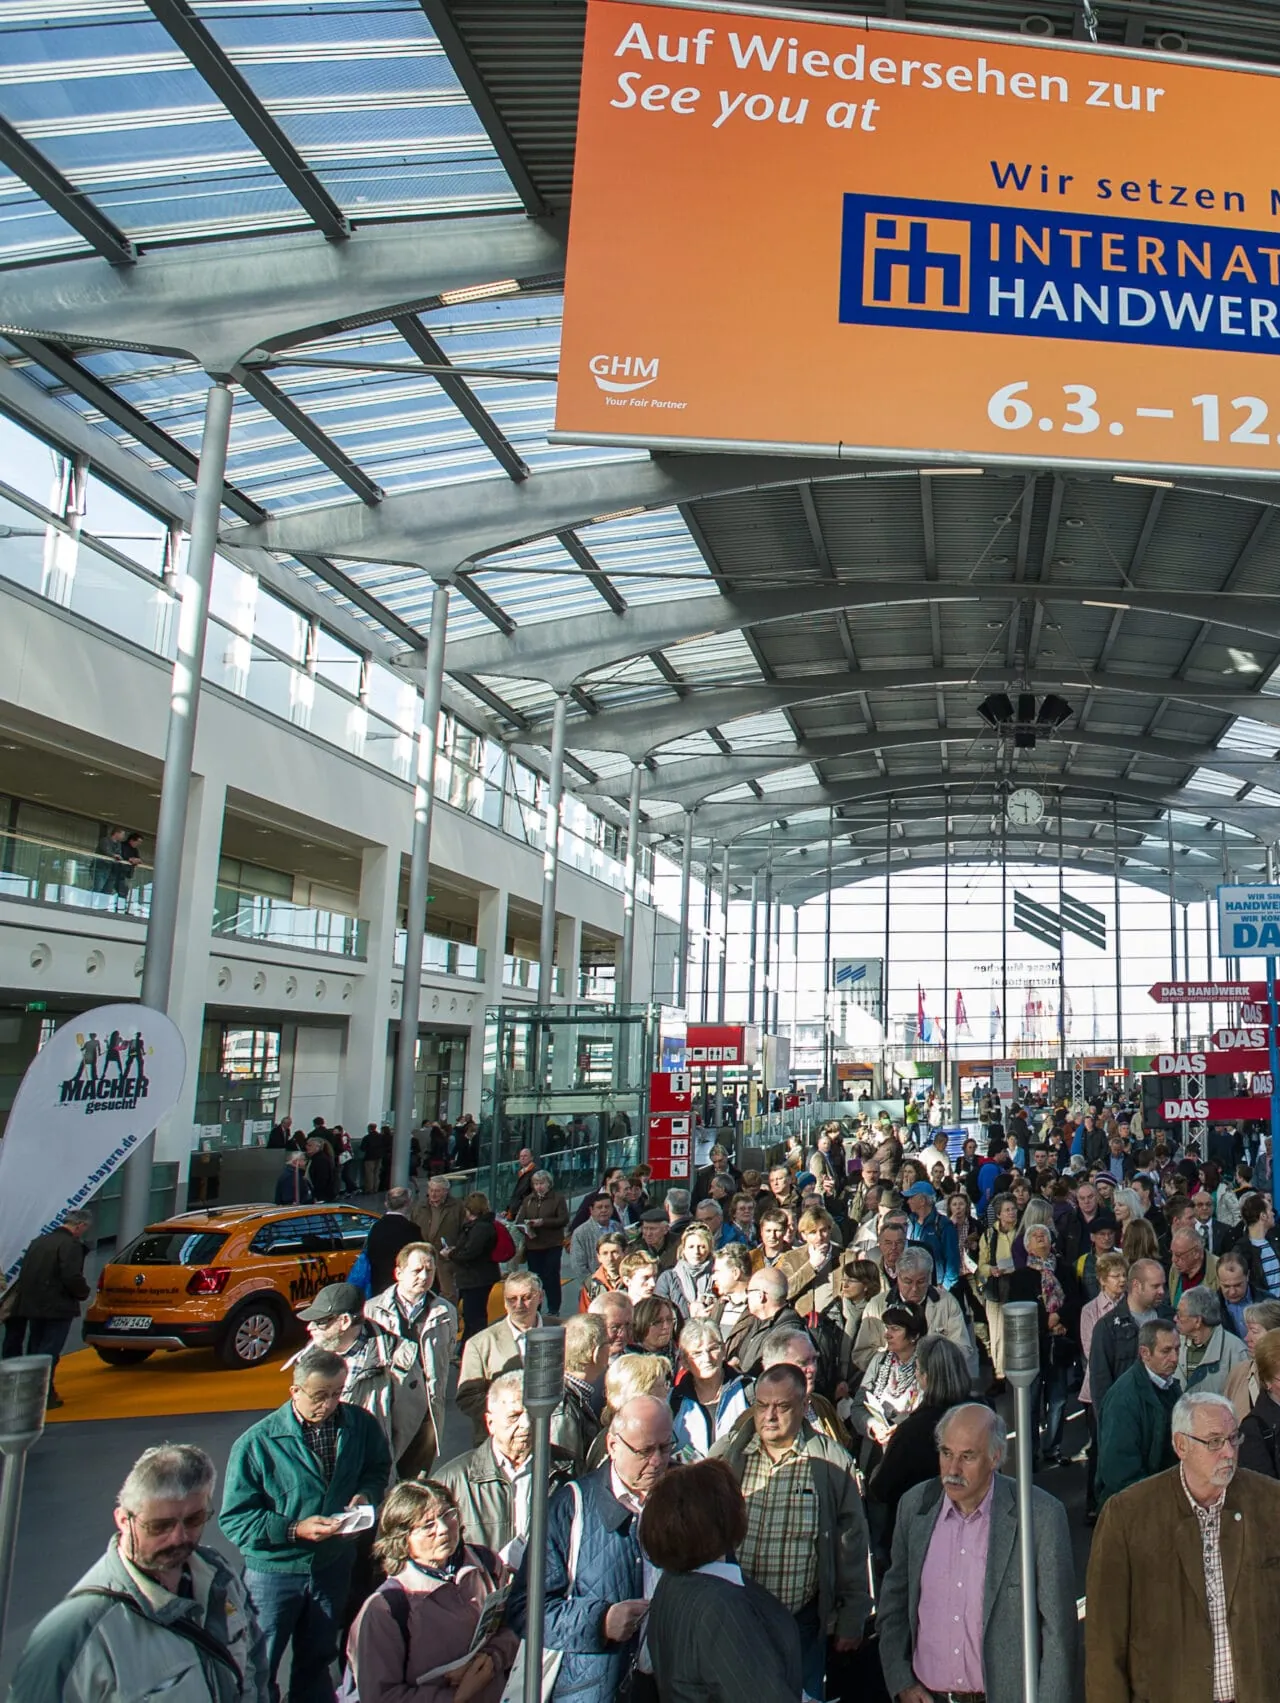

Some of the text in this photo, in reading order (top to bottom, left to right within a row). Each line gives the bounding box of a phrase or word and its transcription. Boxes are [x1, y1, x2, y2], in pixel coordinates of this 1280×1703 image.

[612, 22, 1166, 113] Auf Wiedersehen zur
[610, 71, 881, 132] See you at
[990, 161, 1074, 195] Wir
[1097, 178, 1247, 213] setzen
[589, 354, 660, 378] GHM
[605, 397, 688, 409] Your Fair Partner
[1161, 984, 1250, 997] DAS HANDWERK
[1243, 1003, 1262, 1024] DAS
[1219, 1029, 1265, 1048] DAS
[1158, 1054, 1207, 1074] DAS
[60, 1078, 149, 1102] MACHER
[1252, 1075, 1273, 1094] DAS
[85, 1098, 137, 1114] gesucht!
[1164, 1100, 1210, 1120] DAS
